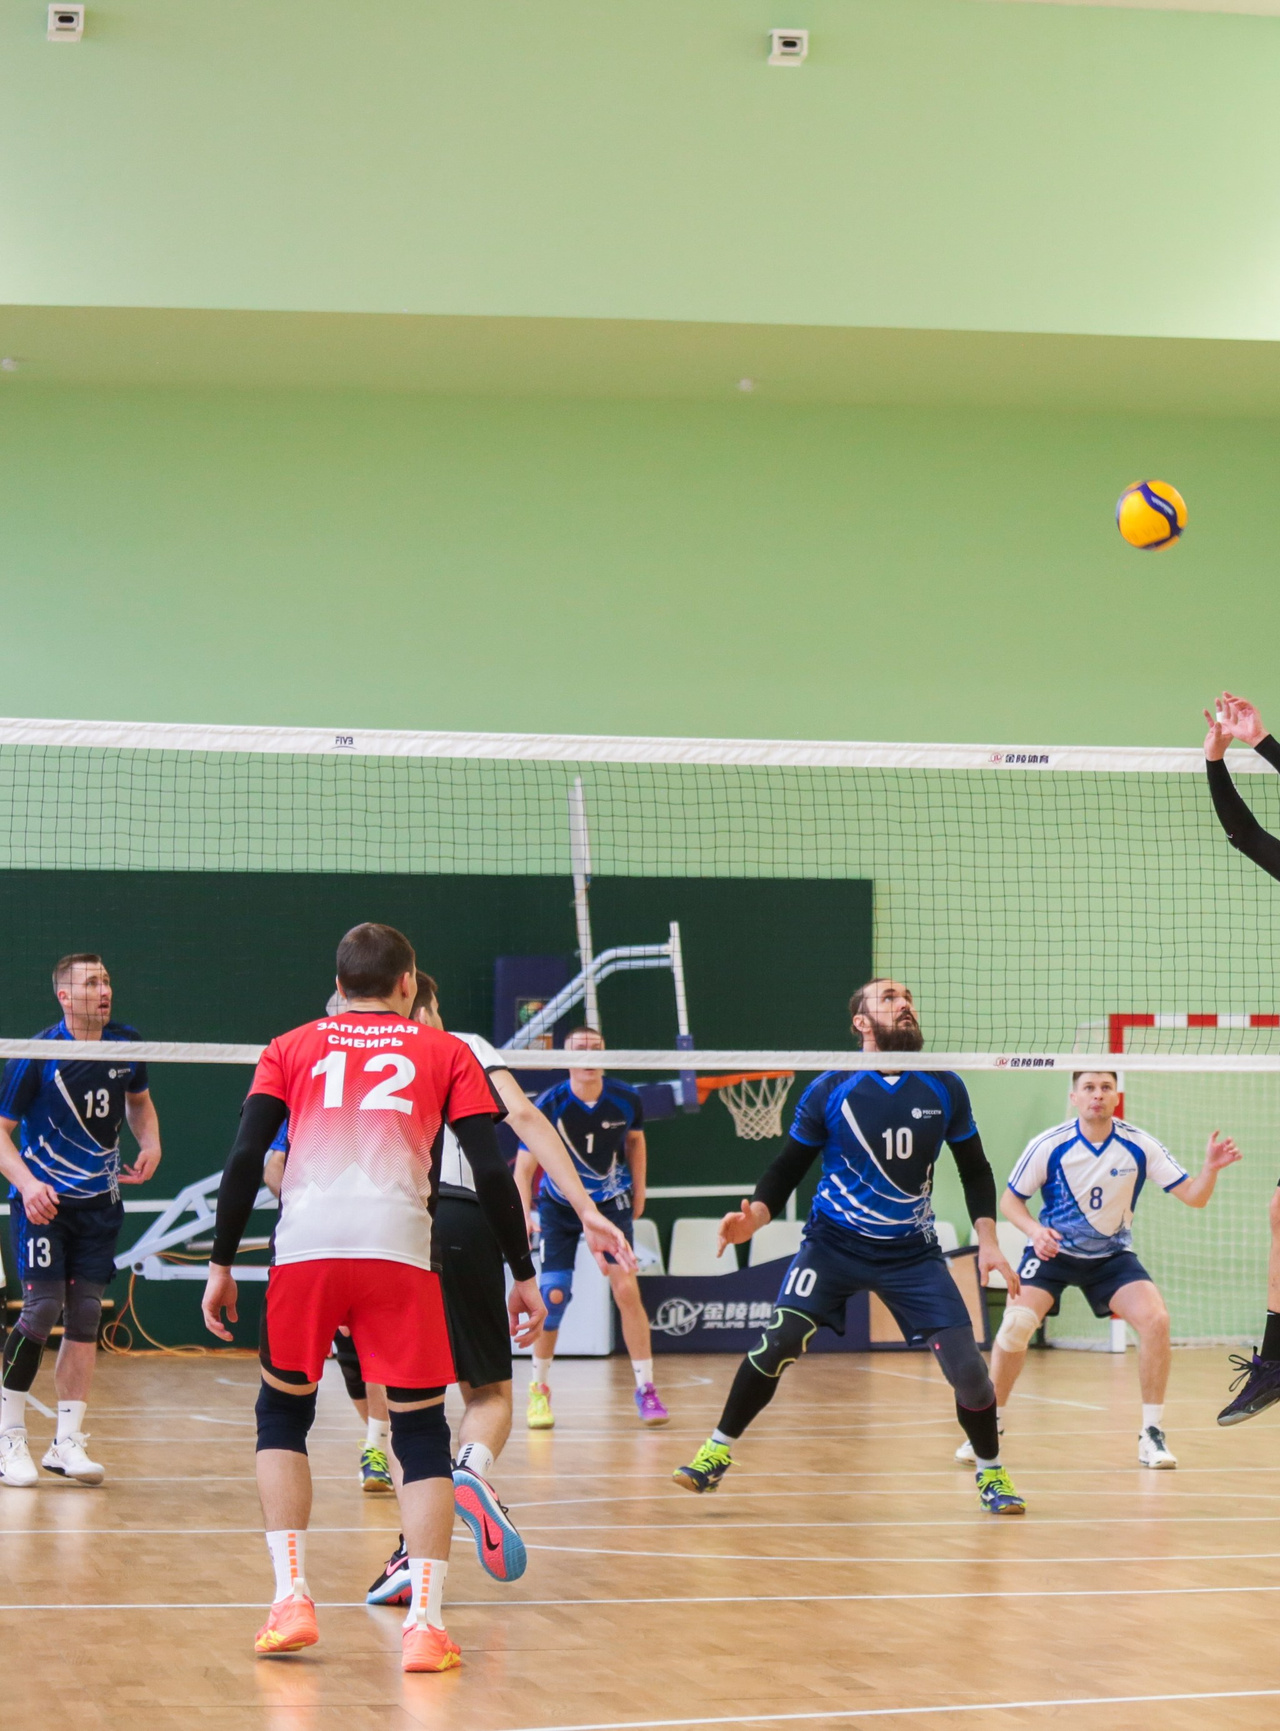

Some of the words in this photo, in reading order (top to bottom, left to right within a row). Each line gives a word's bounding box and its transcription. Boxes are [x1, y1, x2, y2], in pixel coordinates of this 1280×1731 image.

[317, 1022, 419, 1035] ЗАПАДНАЯ
[327, 1034, 404, 1048] СИБИРЬ
[311, 1050, 417, 1116] 12
[84, 1088, 110, 1119] 13
[585, 1133, 594, 1154] 1
[882, 1126, 913, 1160] 10
[1089, 1186, 1103, 1211] 8
[27, 1237, 51, 1268] 13
[1020, 1258, 1041, 1279] 8
[784, 1266, 817, 1298] 10
[702, 1301, 776, 1320] 金陵体
